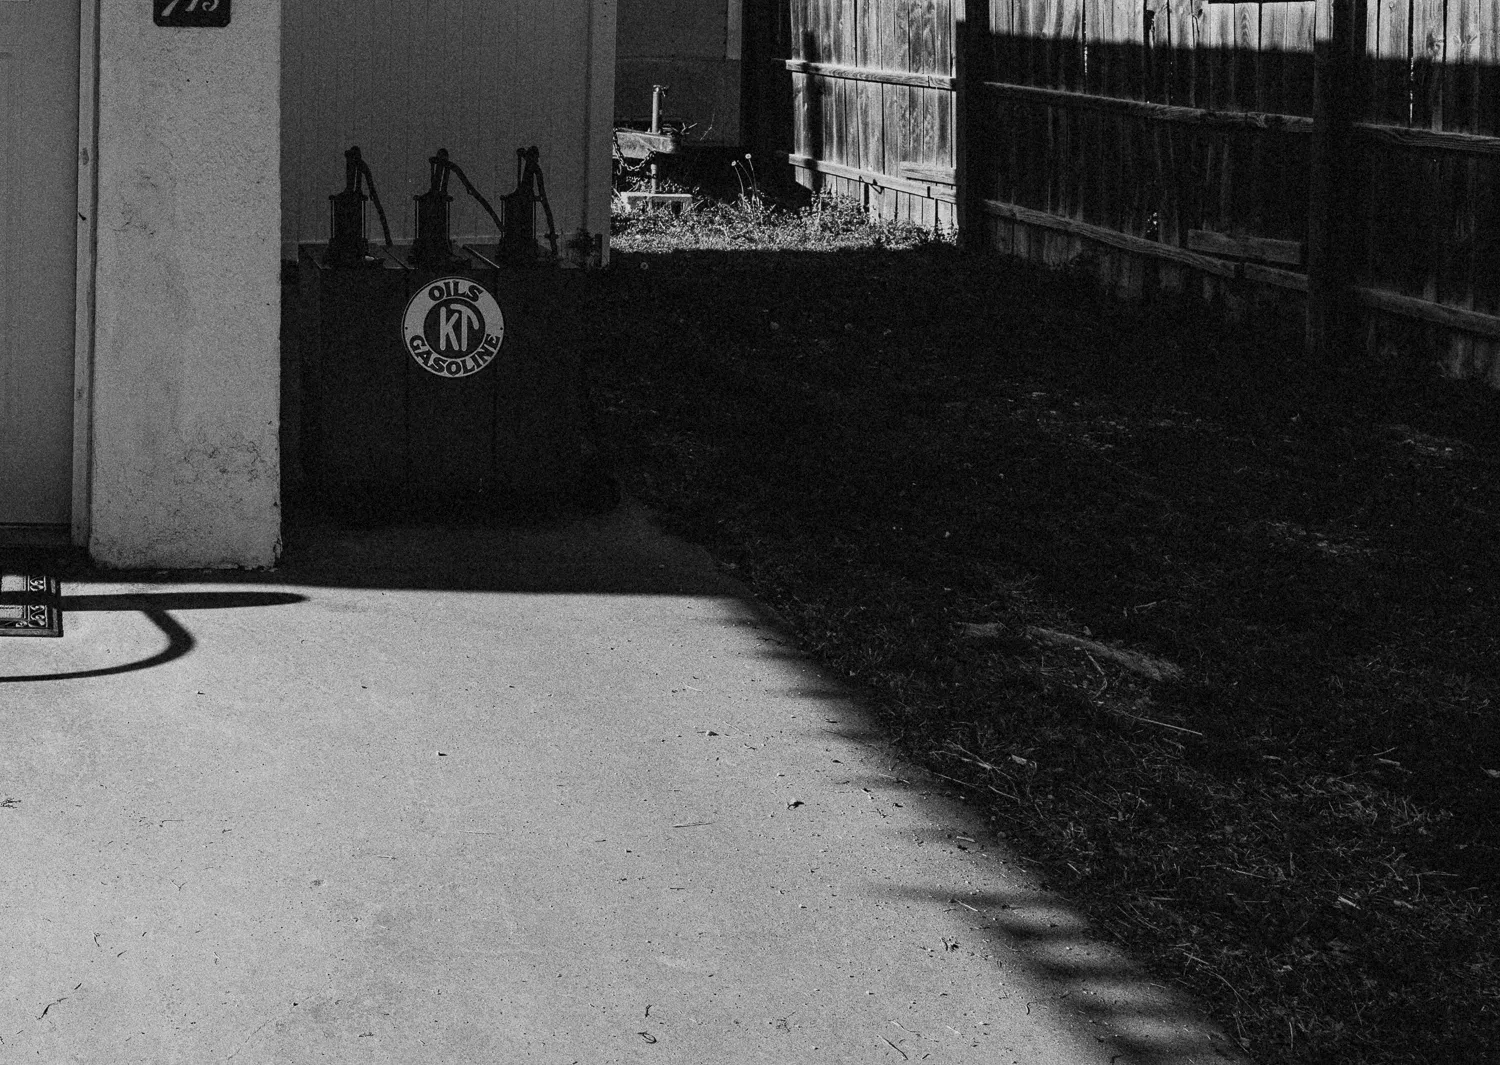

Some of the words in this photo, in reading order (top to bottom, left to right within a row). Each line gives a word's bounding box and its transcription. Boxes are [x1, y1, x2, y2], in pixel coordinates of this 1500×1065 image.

[428, 281, 484, 302] OILS
[439, 303, 479, 351] KT
[409, 334, 501, 375] GASOLINE
